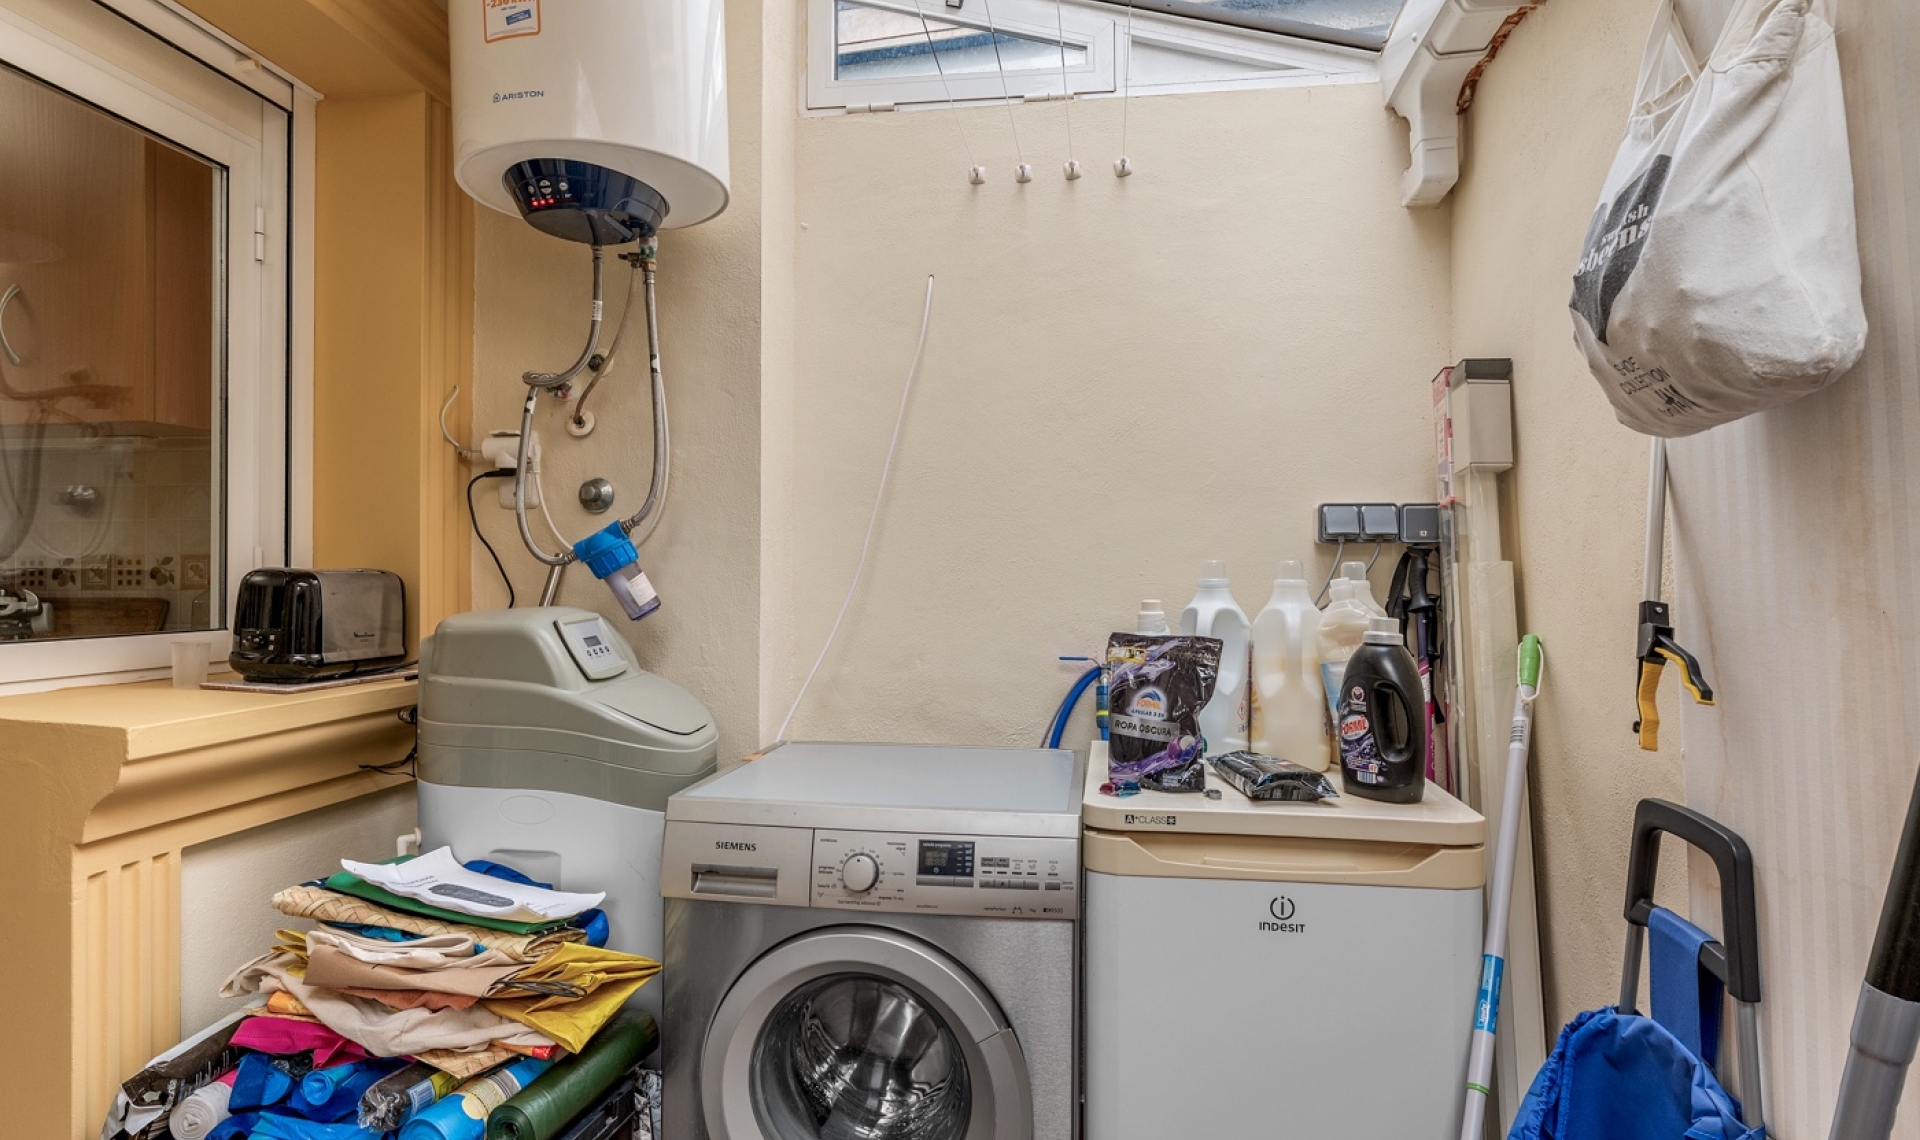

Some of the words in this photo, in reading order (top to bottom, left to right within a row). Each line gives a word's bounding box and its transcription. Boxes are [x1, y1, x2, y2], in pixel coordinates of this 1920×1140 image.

[501, 90, 544, 101] ARISTON
[1136, 699, 1161, 710] FORMIL
[1114, 719, 1138, 732] ROPA
[1139, 724, 1172, 738] OSCURA
[1340, 715, 1367, 737] FORMIL
[715, 840, 757, 852] SIEMENS
